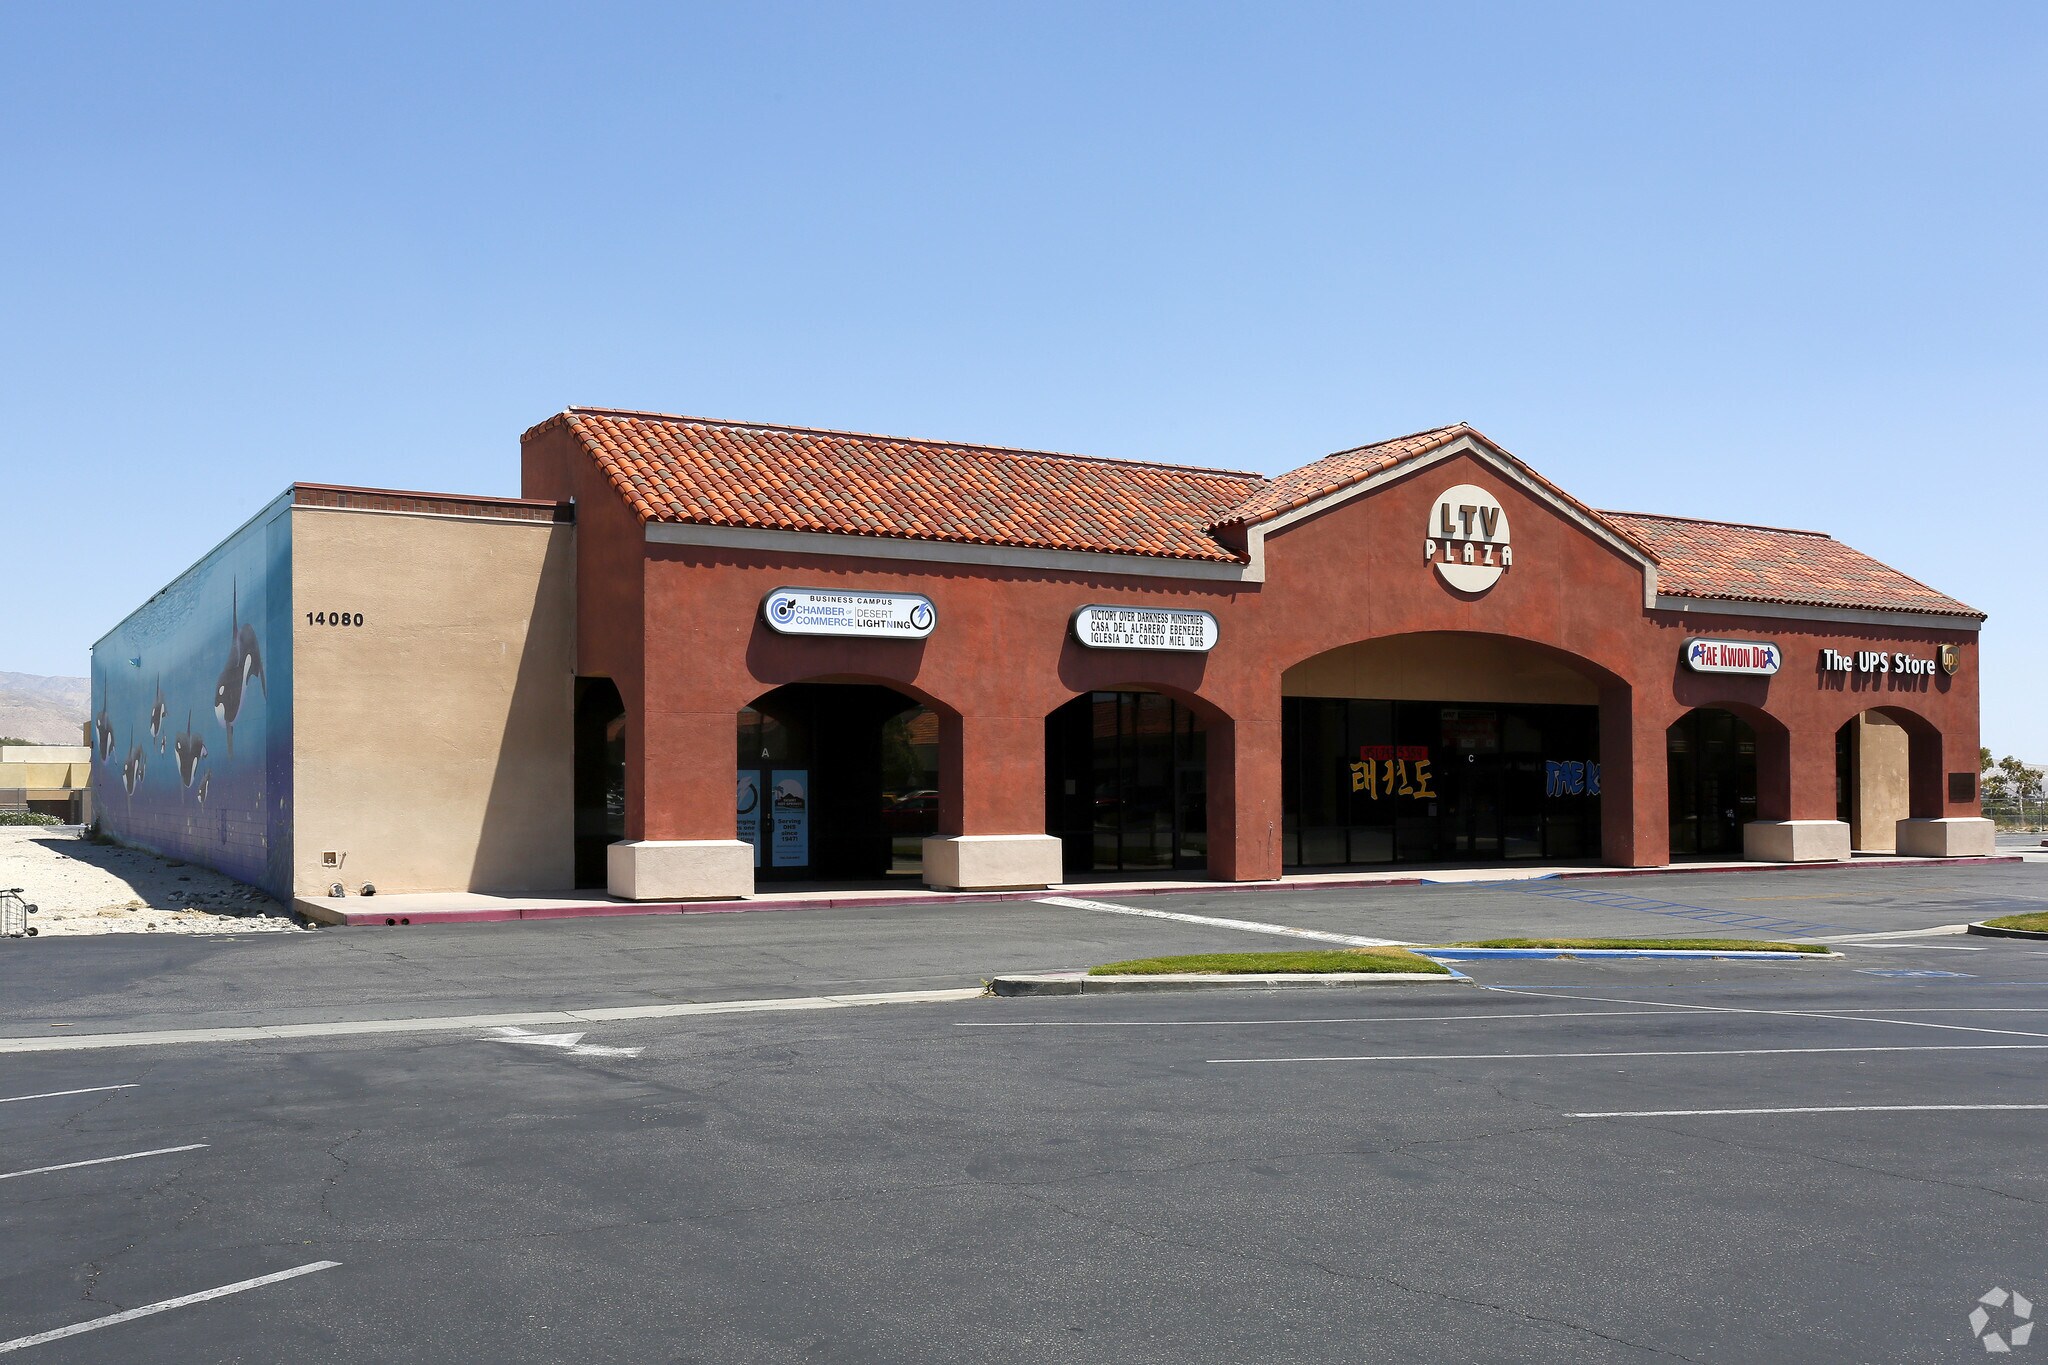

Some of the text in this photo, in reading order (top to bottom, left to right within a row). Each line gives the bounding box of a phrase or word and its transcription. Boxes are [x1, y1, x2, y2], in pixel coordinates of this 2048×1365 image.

[1442, 502, 1500, 537] LTV
[1426, 539, 1513, 566] PLAZA
[810, 595, 892, 606] BUSINESS CAMPUS
[796, 606, 845, 616] CHAMBER
[857, 608, 893, 618] DESERT
[1090, 610, 1204, 625] VICTORY OVER DARKNESS MINISTRIES
[306, 612, 364, 627] 14080
[796, 616, 854, 627] COMMERCE
[857, 619, 911, 629] LIGHTNING
[1090, 621, 1204, 636] CASA DEL ALFARERO EBENEZER
[1090, 632, 1204, 647] IGLESIA DE CRISTO MIEL DHS
[1700, 644, 1766, 668] TAE KWON DO
[1824, 649, 1936, 675] The UPS Store
[1944, 653, 1958, 670] ups
[761, 748, 769, 757] A
[1468, 754, 1475, 763] C
[1545, 759, 1600, 798] TAE K
